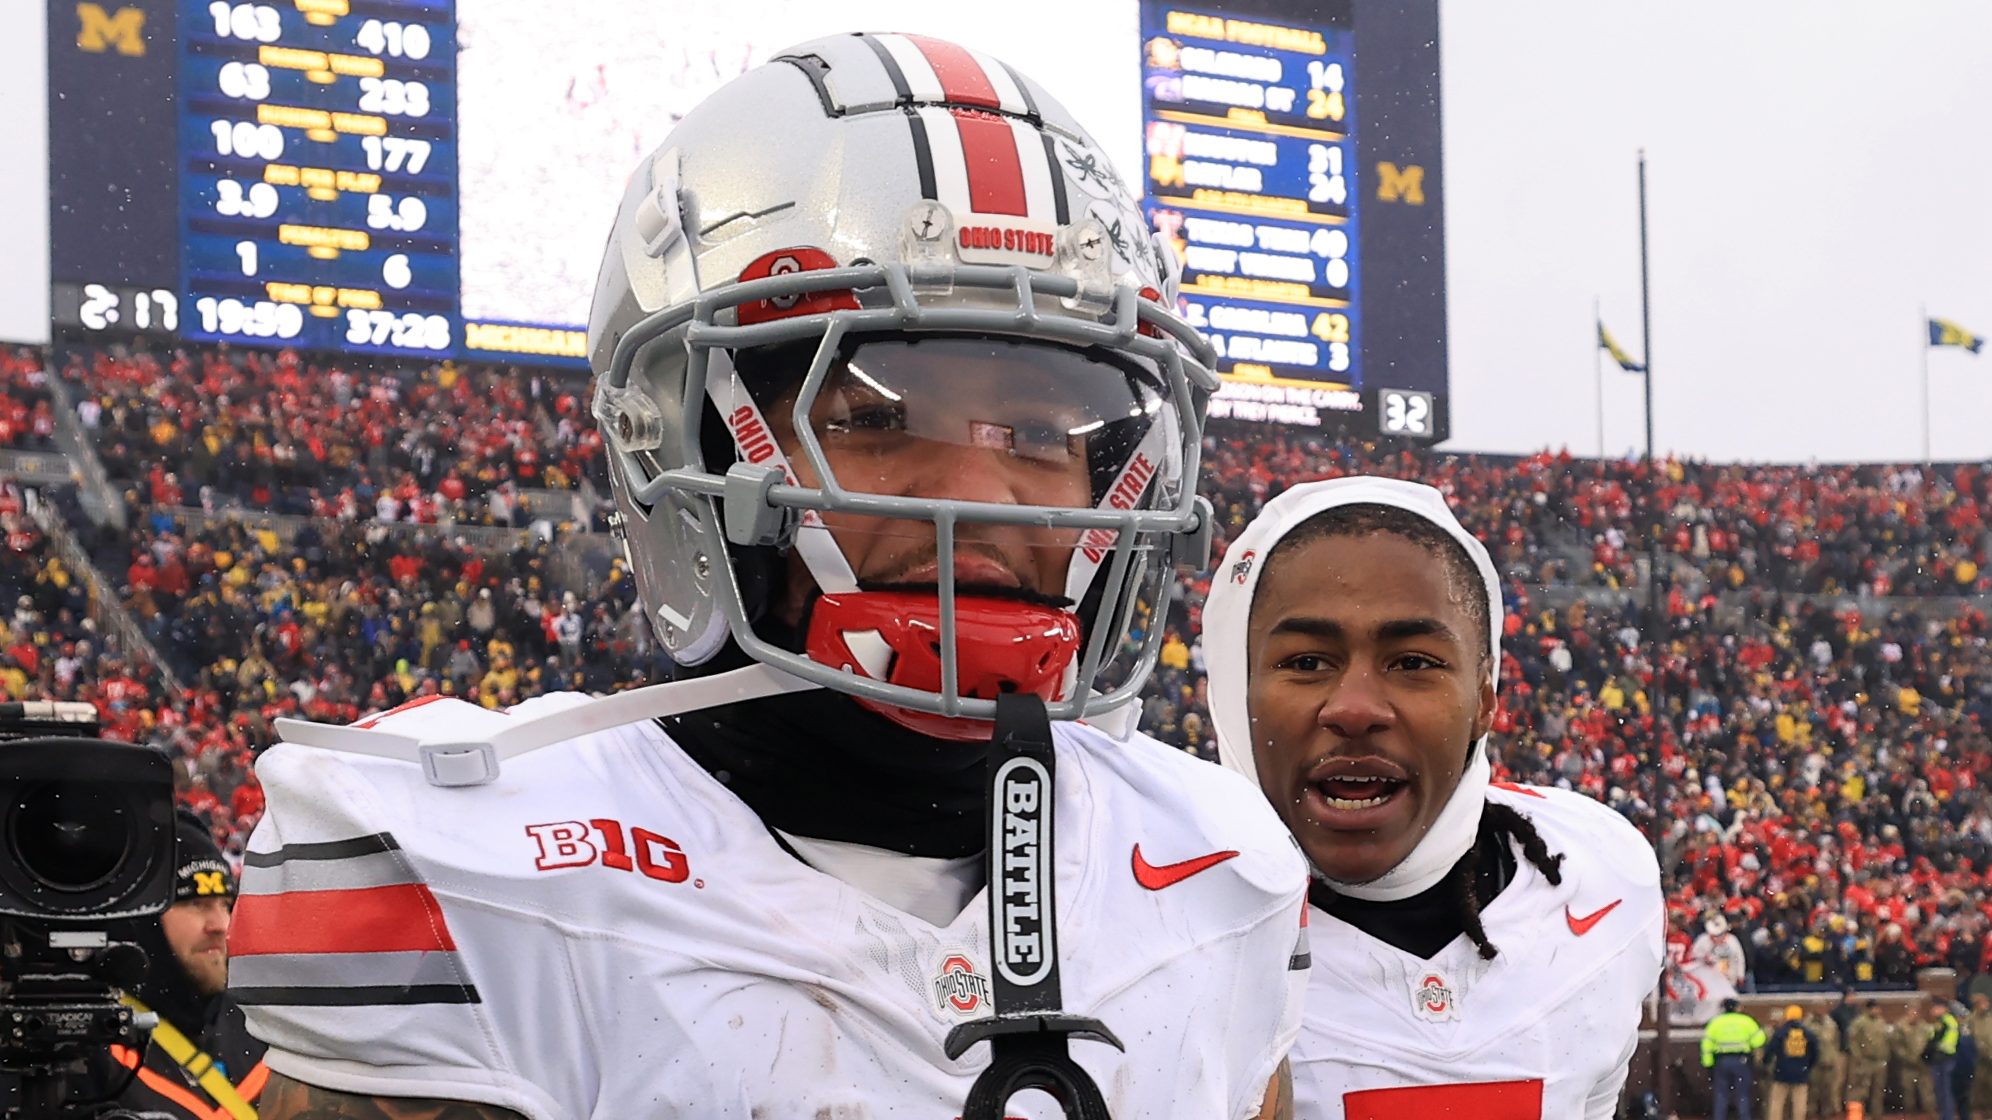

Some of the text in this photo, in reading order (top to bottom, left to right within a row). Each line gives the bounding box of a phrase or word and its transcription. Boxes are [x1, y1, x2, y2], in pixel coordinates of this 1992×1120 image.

[77, 4, 146, 57] M
[209, 1, 281, 43] 163
[357, 19, 430, 60] 410
[218, 61, 270, 100] 63
[1307, 60, 1344, 92] 14
[358, 77, 430, 117] 233
[1306, 88, 1345, 121] 24
[211, 120, 284, 161] 100
[361, 136, 431, 174] 177
[1308, 143, 1342, 175] 31
[216, 179, 279, 219] 3.9
[1308, 172, 1347, 204] 24
[1376, 161, 1424, 206] M
[367, 194, 427, 232] 5.9
[235, 240, 258, 276] 1
[959, 226, 1054, 257] OHIO STATE
[382, 254, 412, 289] 6
[79, 284, 178, 330] 2:17
[196, 297, 303, 338] 19:59
[1311, 312, 1349, 343] 42
[1329, 342, 1349, 372] 3
[1386, 394, 1428, 433] 32
[729, 405, 775, 464] OHIO
[1110, 452, 1154, 510] STATE
[194, 871, 225, 895] M
[1006, 779, 1041, 963] BATTLE
